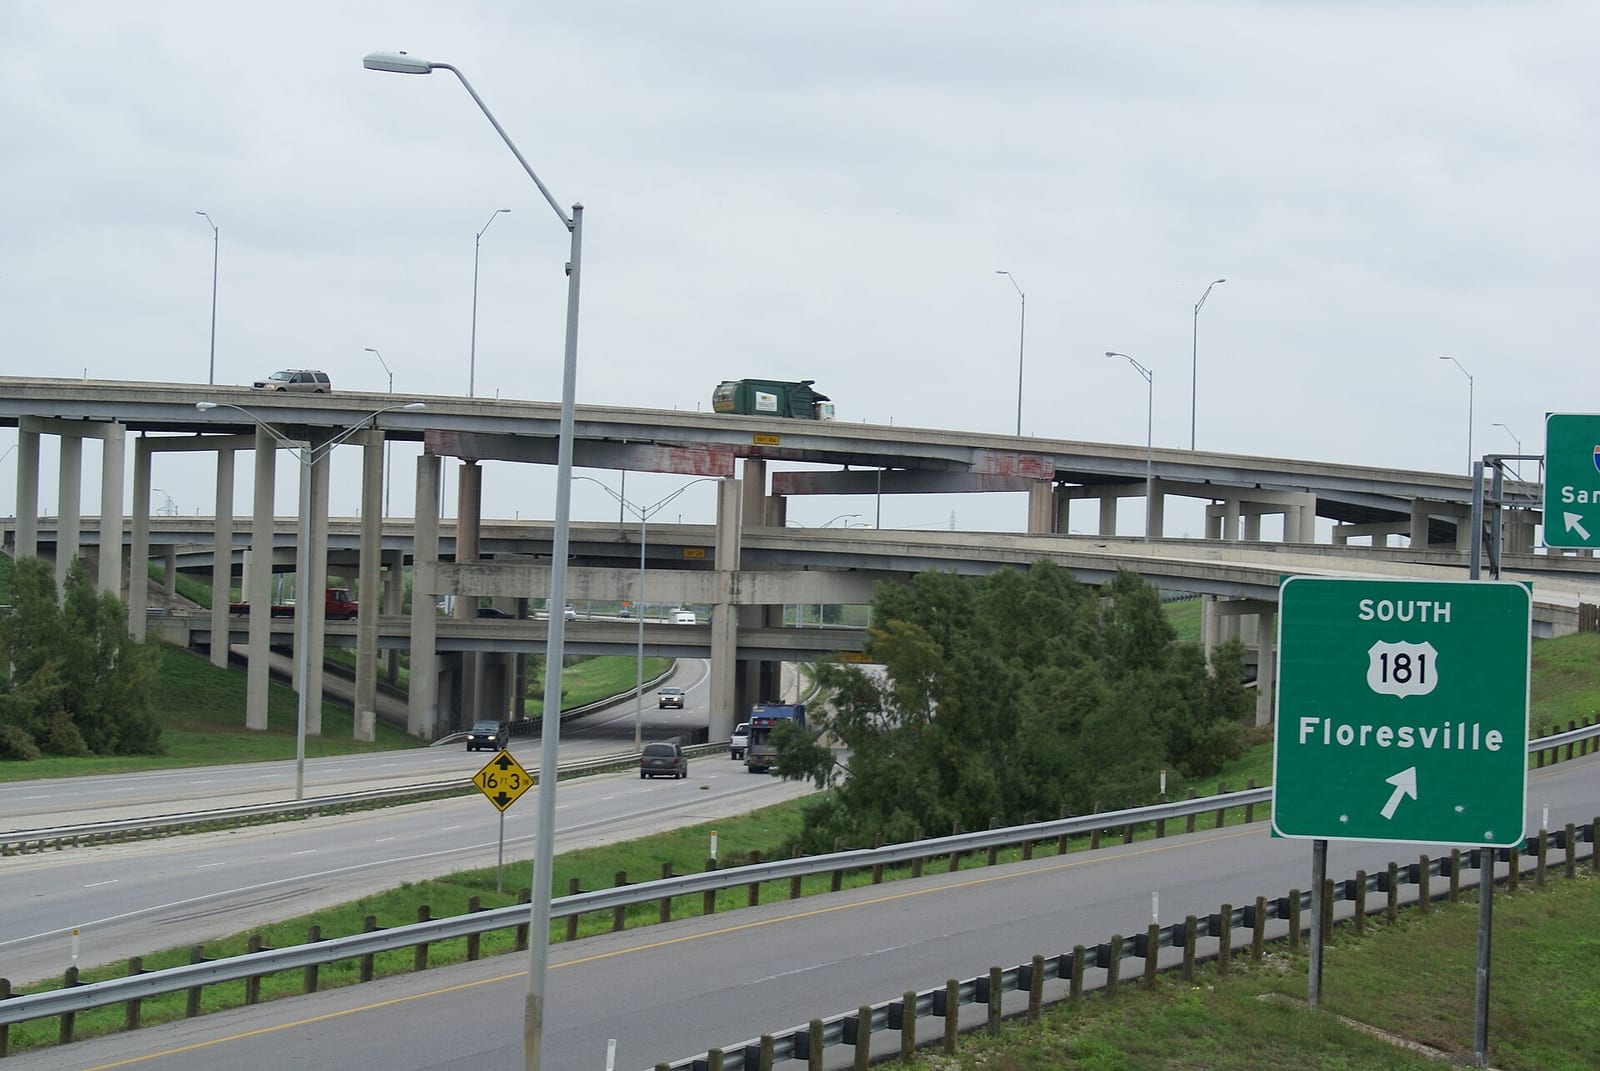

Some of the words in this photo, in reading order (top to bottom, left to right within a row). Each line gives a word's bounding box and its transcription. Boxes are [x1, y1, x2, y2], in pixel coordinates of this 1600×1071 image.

[1358, 598, 1452, 623] SOUTH
[1380, 652, 1426, 684] 181
[1299, 717, 1504, 752] Floresville
[482, 772, 498, 789] 16
[509, 773, 520, 790] 3
